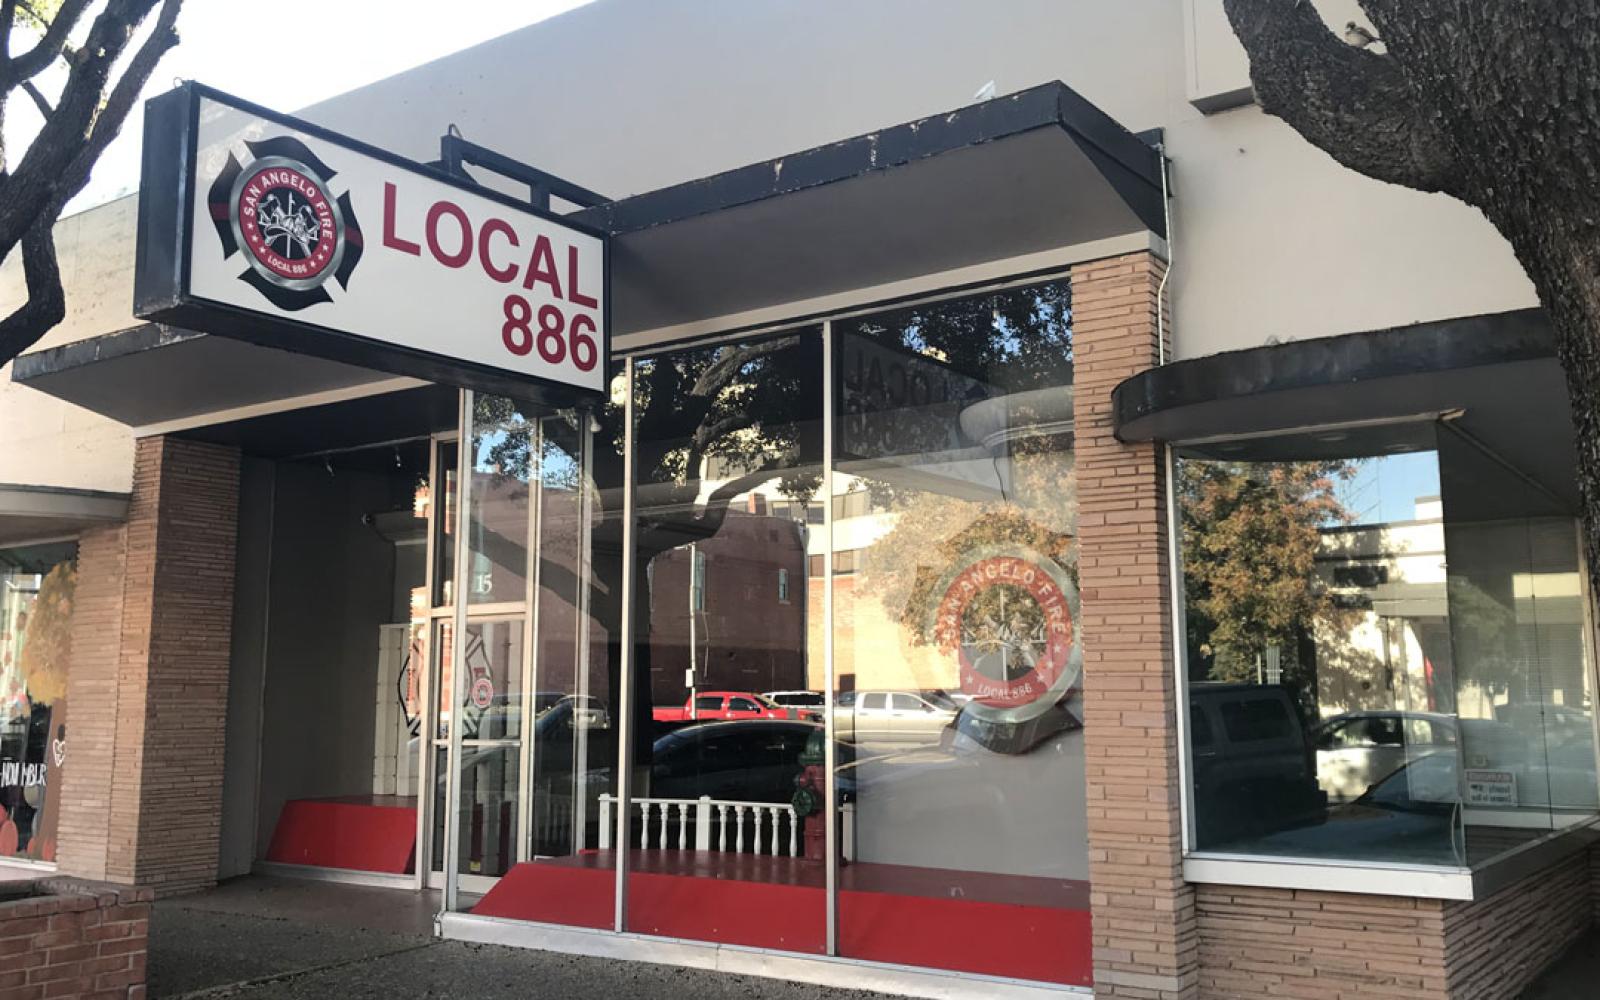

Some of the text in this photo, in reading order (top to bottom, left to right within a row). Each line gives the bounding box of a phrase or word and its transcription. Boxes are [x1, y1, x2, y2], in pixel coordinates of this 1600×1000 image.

[244, 172, 333, 240] SAN ANGELO FIRE
[267, 255, 308, 274] LOCAL 886
[382, 181, 598, 310] LOCAL
[501, 294, 598, 373] 886
[943, 562, 1066, 641] SAN ANGELO FIRE
[977, 684, 1033, 701] LOCAL 886
